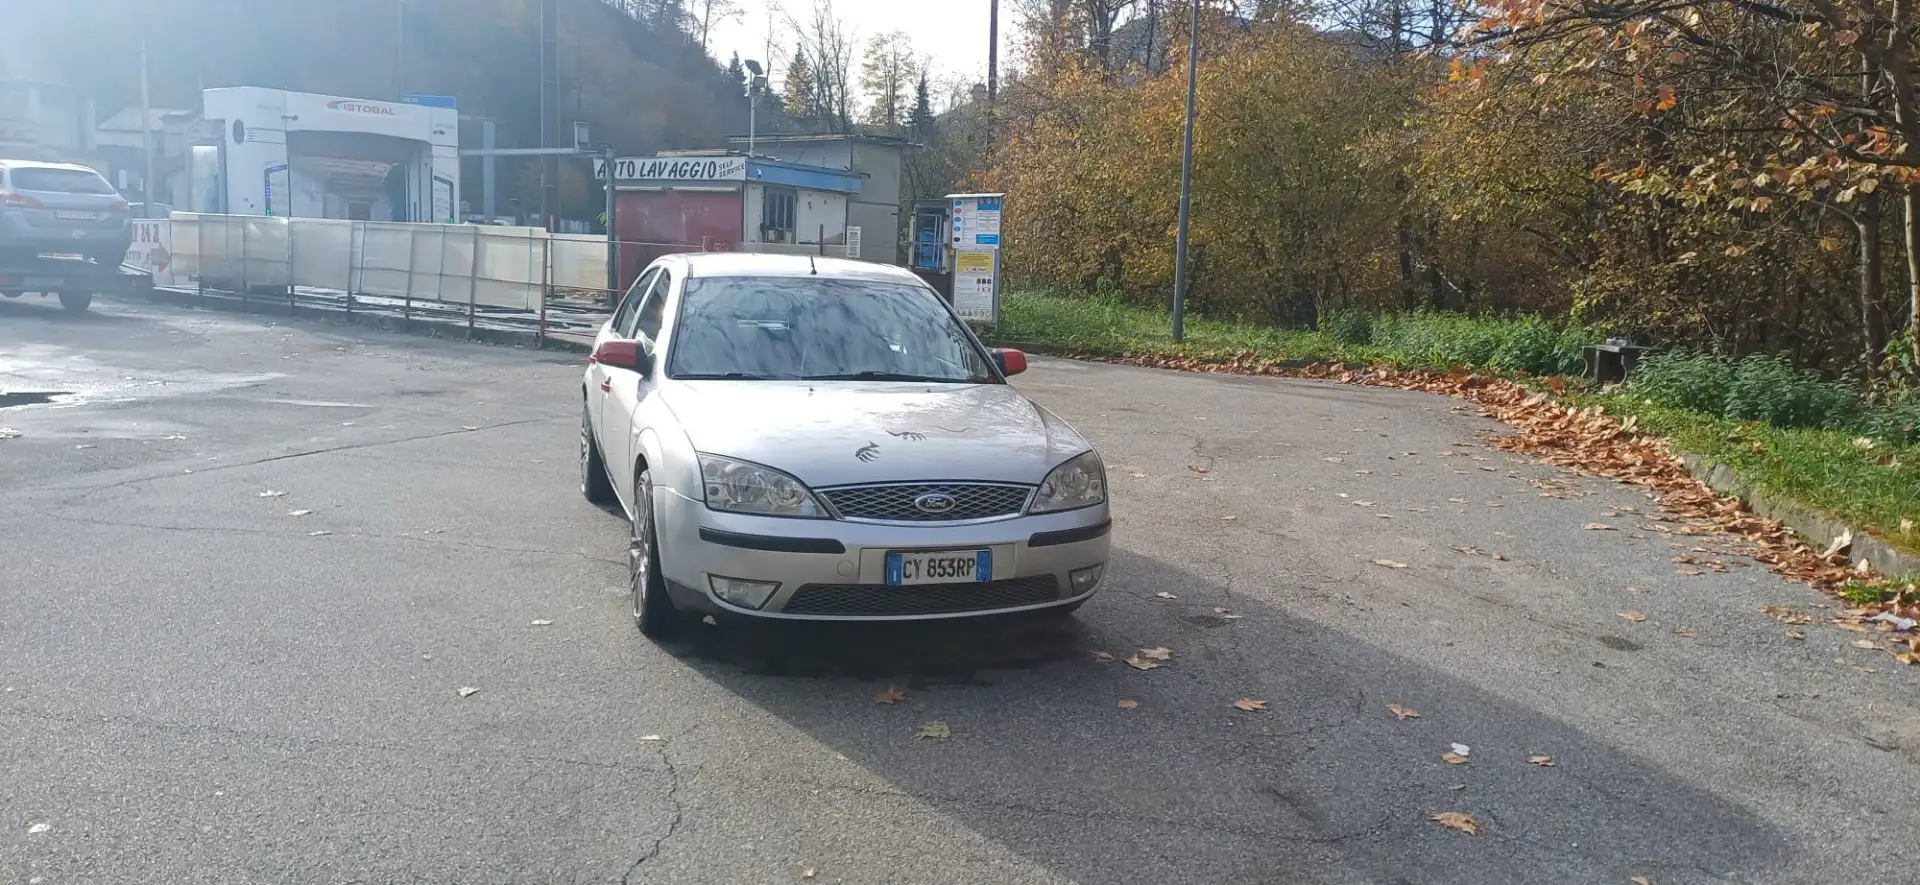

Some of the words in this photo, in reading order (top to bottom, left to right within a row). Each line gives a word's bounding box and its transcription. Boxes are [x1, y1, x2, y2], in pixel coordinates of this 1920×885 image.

[343, 103, 396, 116] ISTOBAL
[597, 160, 635, 178] ATO
[925, 497, 947, 508] Ford
[903, 560, 921, 579] CY
[927, 558, 975, 577] 853RP
